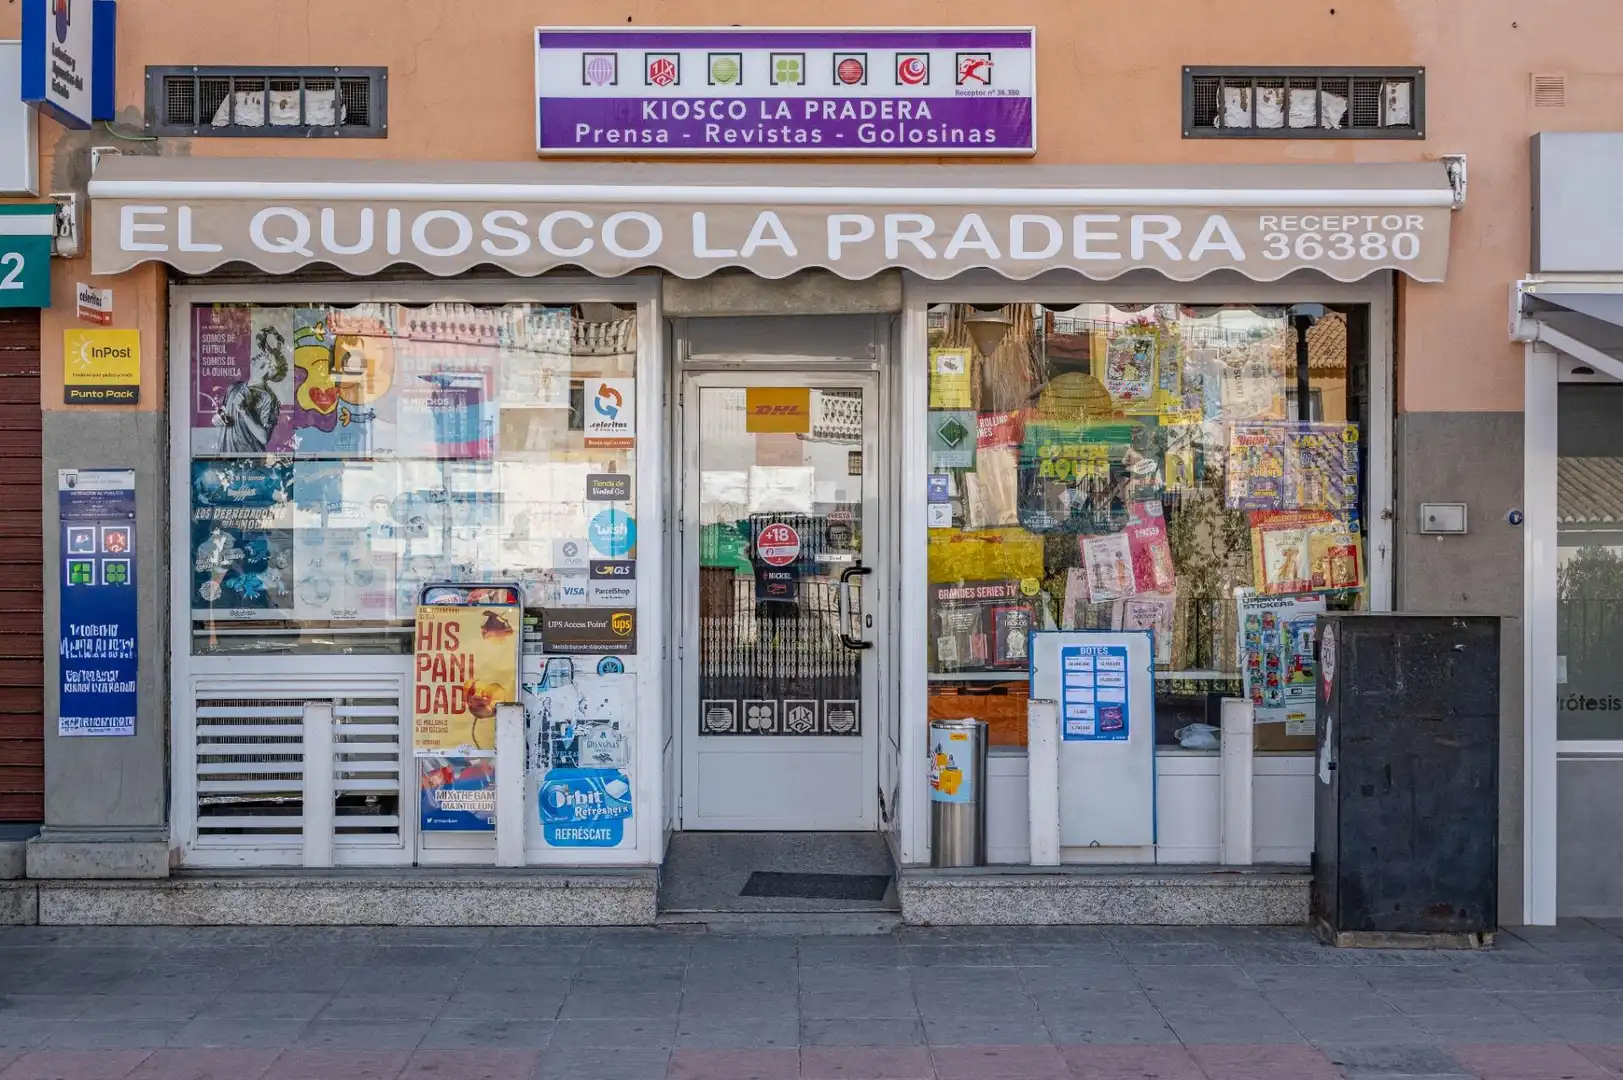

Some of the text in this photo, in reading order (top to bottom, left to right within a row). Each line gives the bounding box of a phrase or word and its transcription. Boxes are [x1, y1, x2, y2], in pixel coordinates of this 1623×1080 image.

[643, 100, 932, 120] KIOSCO LA PRADERA
[576, 124, 669, 144] Prensa
[705, 123, 822, 144] Revistas
[858, 123, 997, 144] Golosinas
[1260, 214, 1425, 231] RECEPTOR
[120, 205, 1246, 263] EL QUIOSCO LA PRADERA
[1262, 232, 1420, 261] 36380
[0, 252, 25, 289] 2
[202, 333, 236, 343] SOMOS DE
[92, 347, 131, 358] InPost
[202, 356, 236, 366] SOMOS DE
[202, 367, 242, 377] LA QUINIELA
[71, 390, 133, 398] Punto Pack
[755, 404, 800, 415] DHL
[196, 508, 211, 519] LOS
[765, 528, 789, 542] +18
[614, 566, 630, 575] GLS
[562, 587, 585, 595] VISA
[938, 588, 976, 600] GRANDES
[977, 586, 1005, 597] SERIES
[1007, 584, 1018, 596] TV
[1243, 601, 1294, 609] STICKERS
[614, 620, 631, 632] ups
[417, 621, 460, 651] HIS
[1080, 647, 1109, 655] BOTES
[416, 653, 475, 683] PANI
[416, 685, 467, 715] DAD
[1557, 693, 1622, 711] rótesis
[474, 791, 495, 800] GAM
[574, 805, 629, 819] Refreshers
[555, 826, 612, 840] REFRÉSCATE
